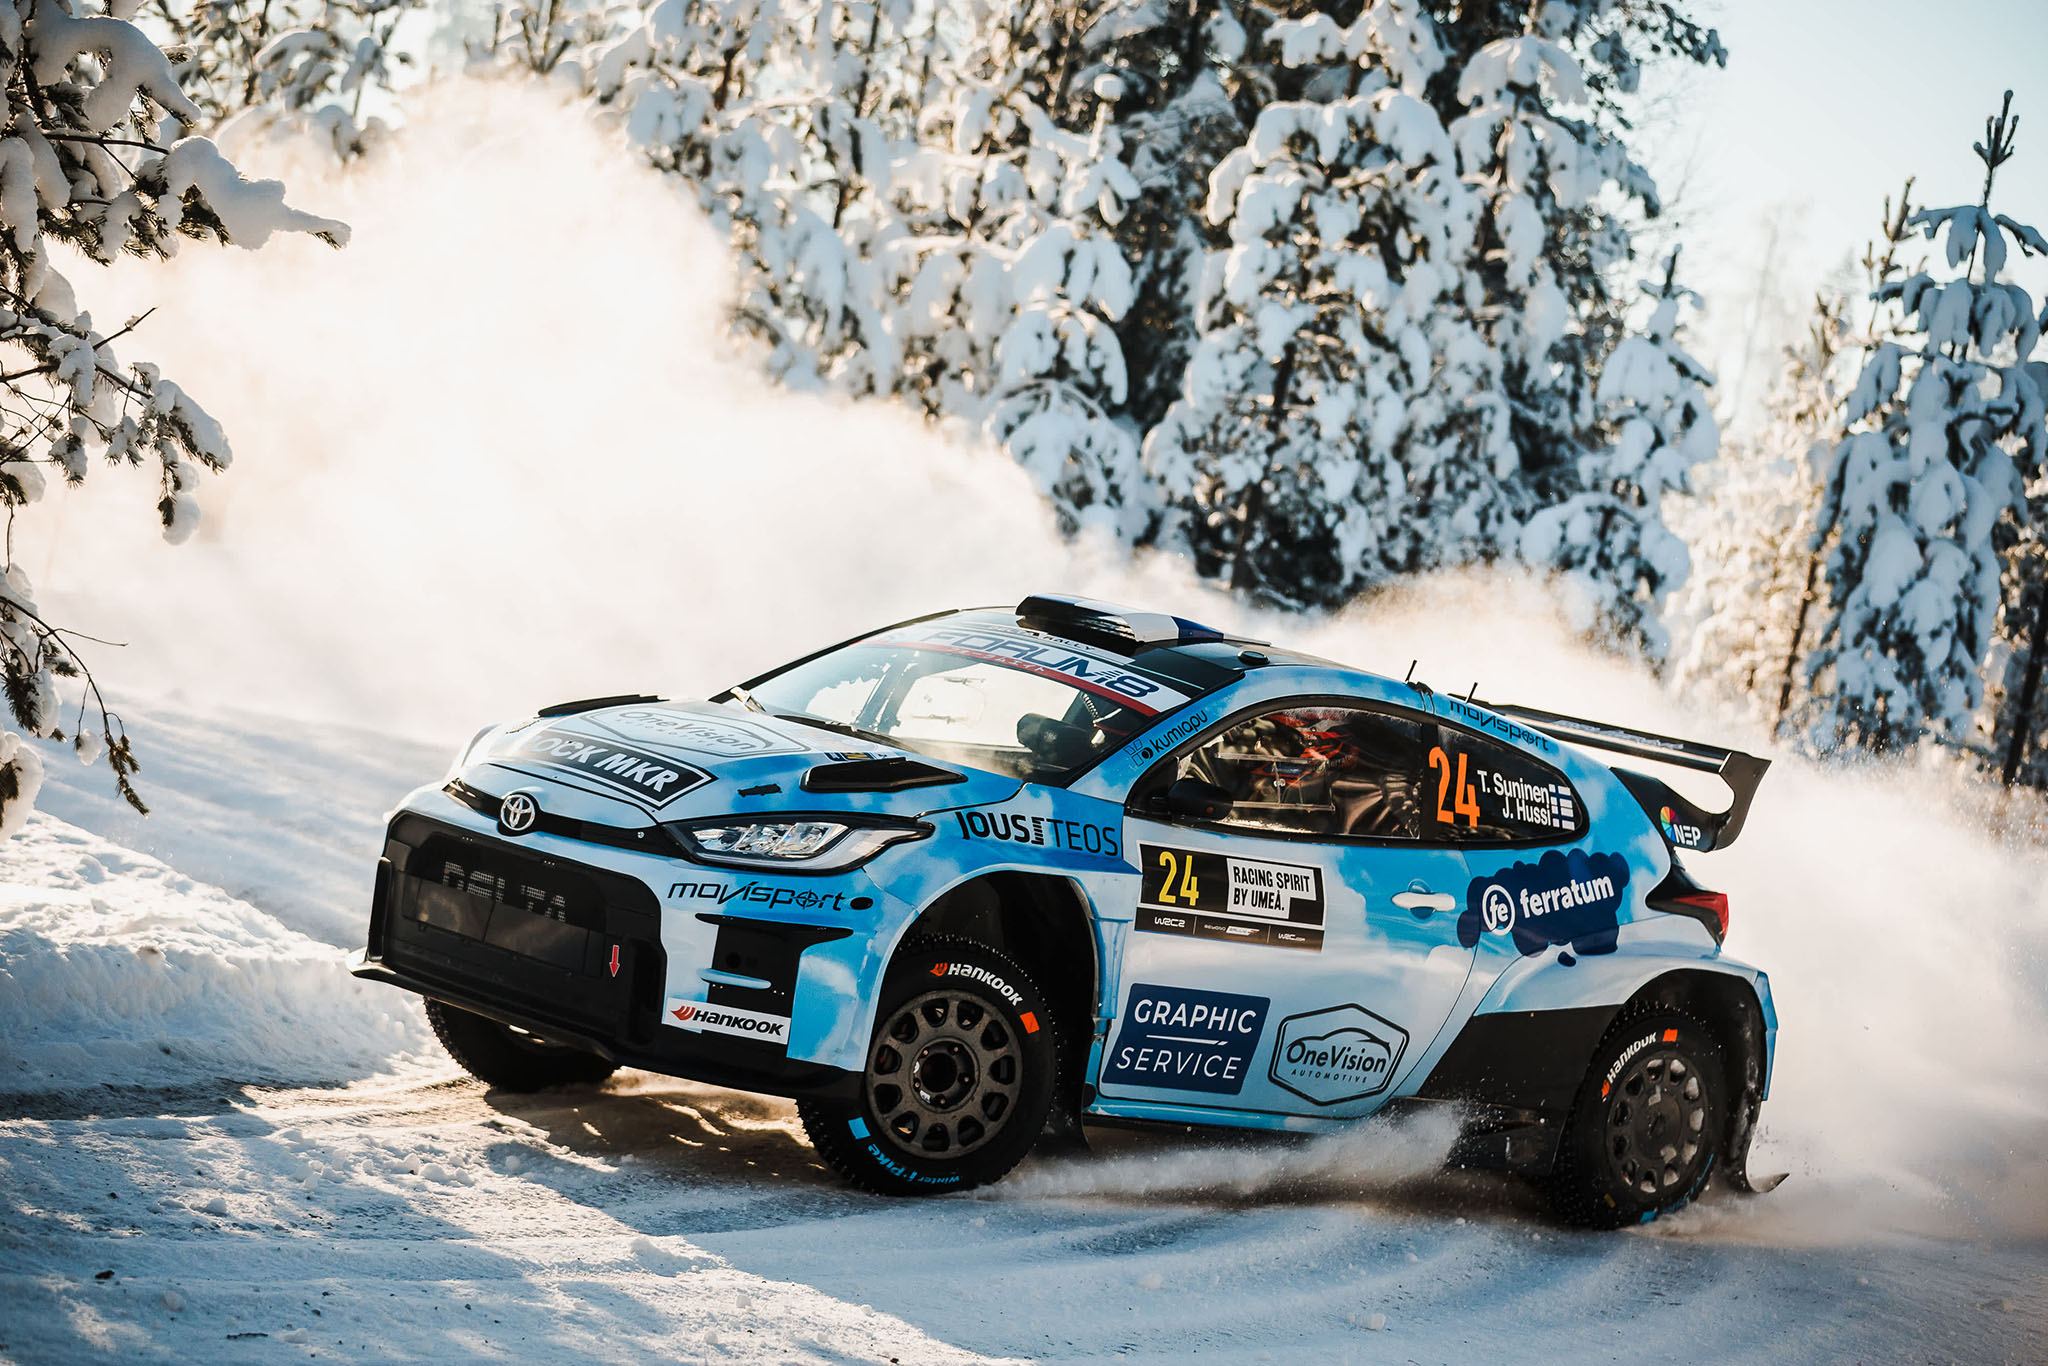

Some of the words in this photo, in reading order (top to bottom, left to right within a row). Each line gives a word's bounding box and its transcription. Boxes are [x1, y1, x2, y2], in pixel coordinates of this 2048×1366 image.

[594, 752, 679, 793] MKR
[1428, 746, 1480, 828] 24
[1477, 770, 1491, 793] T.
[1493, 772, 1550, 804] Suninen
[1502, 796, 1514, 819] J.
[1517, 798, 1551, 826] Hussi
[1158, 851, 1199, 906] 24
[1233, 866, 1273, 887] RACING
[1276, 871, 1310, 892] SPIRIT
[1233, 887, 1248, 905] BY
[1520, 875, 1615, 919] ferratum
[1134, 999, 1257, 1034] GRAPHIC
[1116, 1047, 1242, 1080] SERVICE
[1286, 1041, 1387, 1073] OneVision
[1291, 1068, 1367, 1083] AUTOMOTIVE
